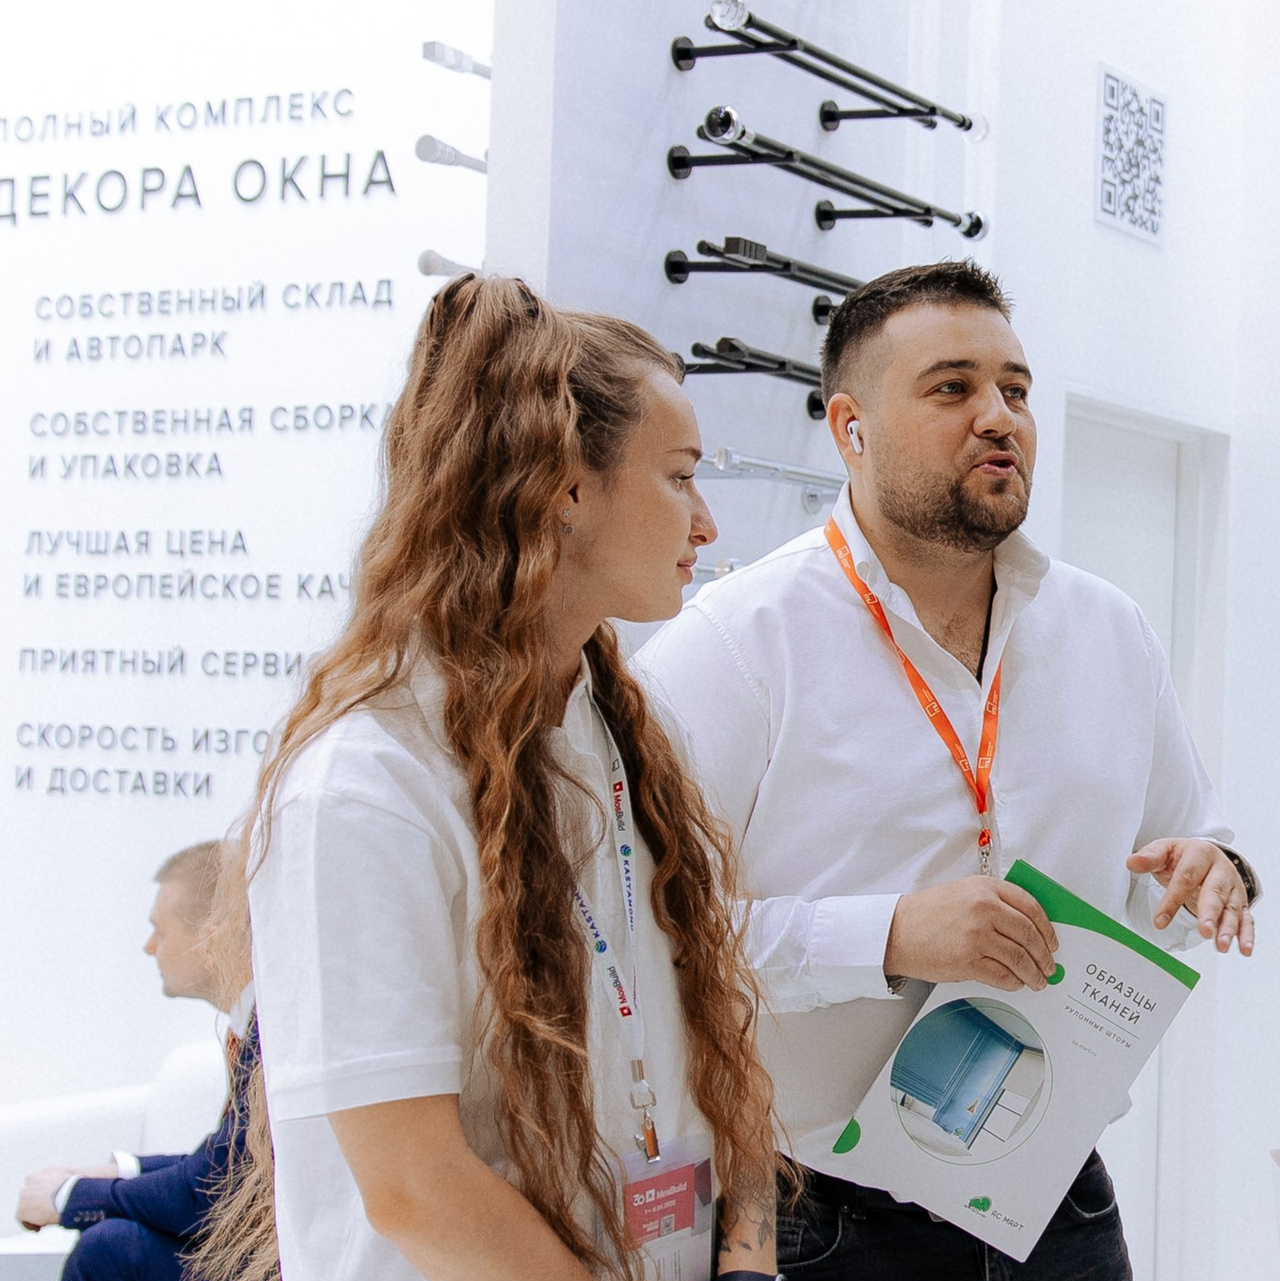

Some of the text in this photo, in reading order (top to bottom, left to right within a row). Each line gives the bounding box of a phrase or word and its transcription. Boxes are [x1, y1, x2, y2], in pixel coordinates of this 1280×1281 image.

[155, 88, 355, 130] КОМПЛЕКС
[0, 150, 396, 226] ДЕКОРА ОКНА
[35, 279, 394, 321] СОБСТВЕННЫЙ СКЛАД
[33, 331, 228, 362] И АВТОПАРК
[30, 406, 253, 438] СОБСТВЕННАЯ
[28, 452, 223, 479] И УПАКОВКА
[24, 529, 248, 558] ЛУЧШАЯ ЦЕНА
[22, 573, 40, 598] И
[55, 567, 281, 599] ЕВРОПЕЙСКОЕ
[18, 645, 302, 677] ПРИЯТНЫЙ СЕРВИ
[16, 723, 177, 752] СКОРОСТЬ
[14, 767, 213, 798] И ДОСТАВКИ
[613, 794, 626, 832] MosBuild
[607, 965, 628, 1004] MosBuild
[1085, 963, 1157, 1013] ОБРАЗЦЫ
[1081, 981, 1141, 1025] ТКАНЕЙ
[1064, 1005, 1132, 1048] РУЛОННЫЕ ШТОРЫ
[656, 1182, 687, 1199] MosBuild
[1003, 1216, 1024, 1231] МАРТ
